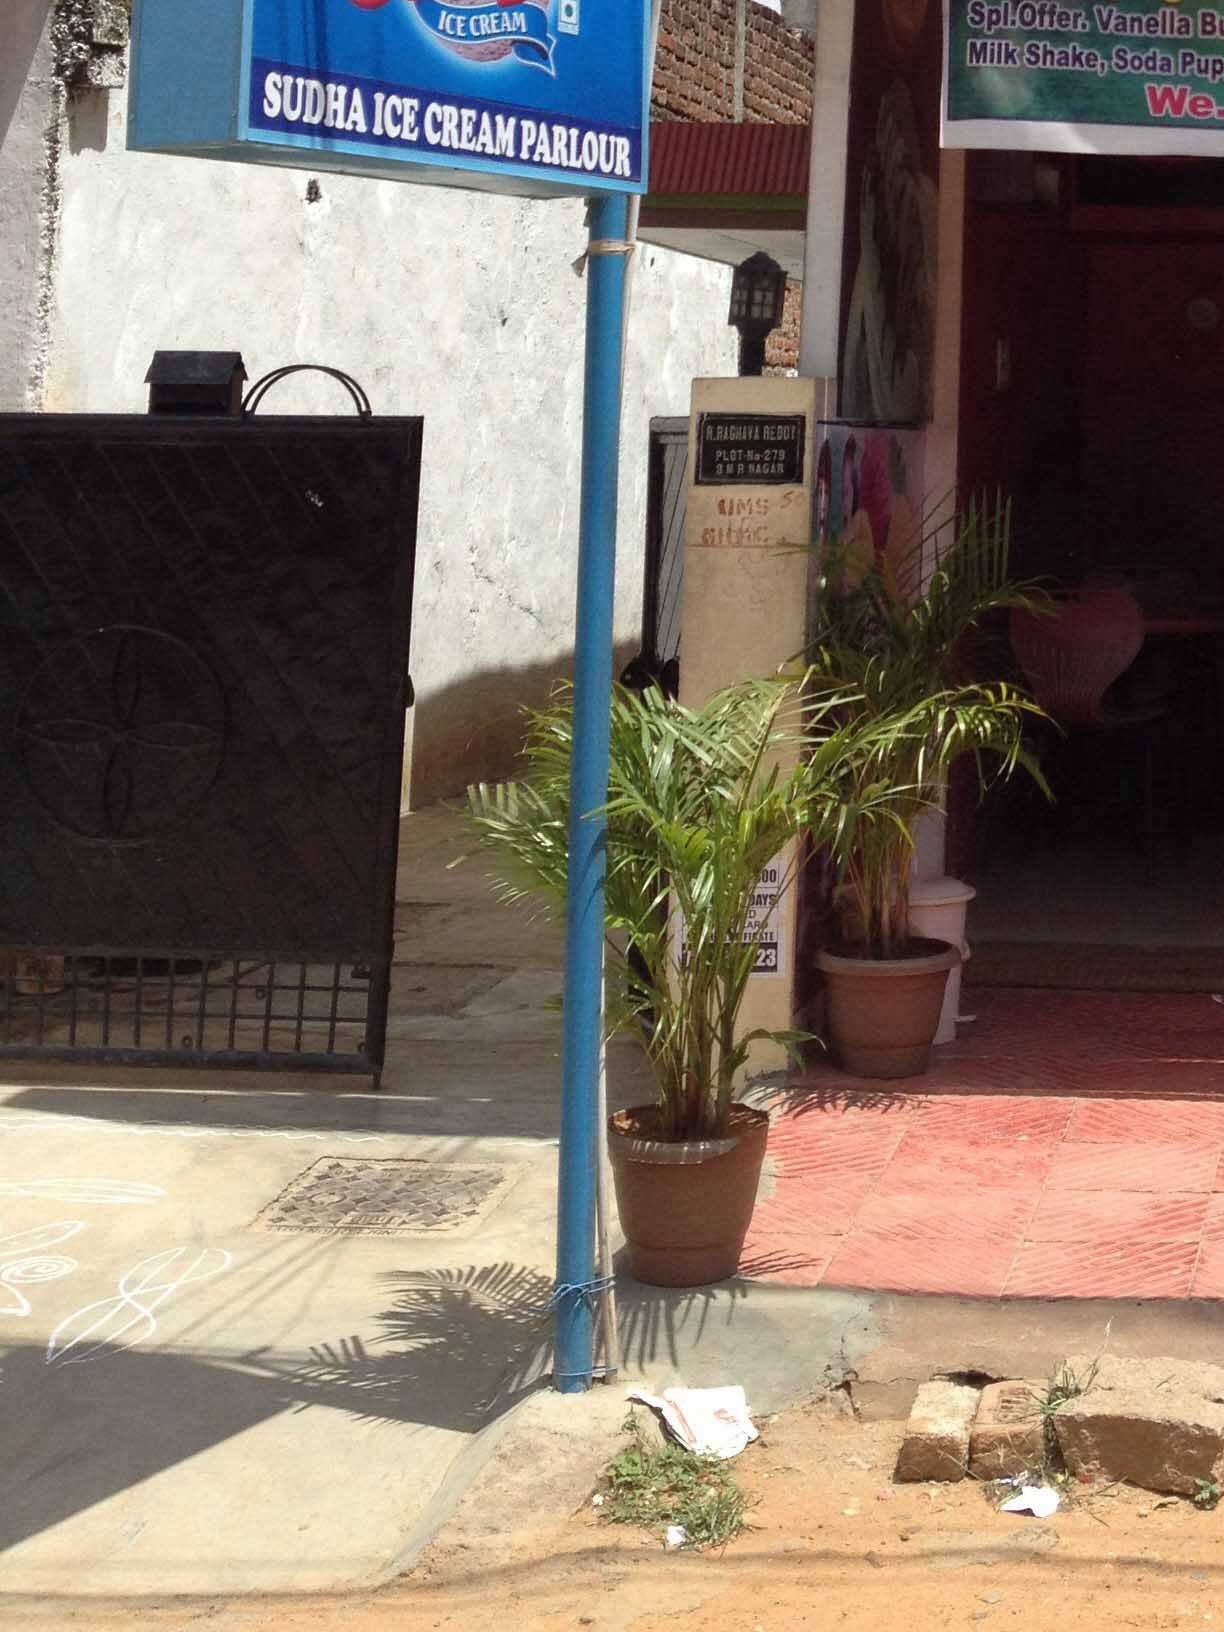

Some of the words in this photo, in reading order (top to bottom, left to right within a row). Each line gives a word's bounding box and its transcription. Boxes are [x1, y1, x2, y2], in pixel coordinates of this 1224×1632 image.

[437, 9, 466, 38] ICE
[468, 11, 527, 37] CREAM
[1095, 6, 1191, 39] Vanella
[968, 41, 1018, 66] Milk
[1023, 41, 1107, 74] Shake,
[1112, 47, 1173, 74] Soda
[263, 71, 368, 133] SUDHA
[372, 91, 419, 142] ICE
[423, 101, 516, 158] CREAM
[520, 116, 632, 177] PARLOUR
